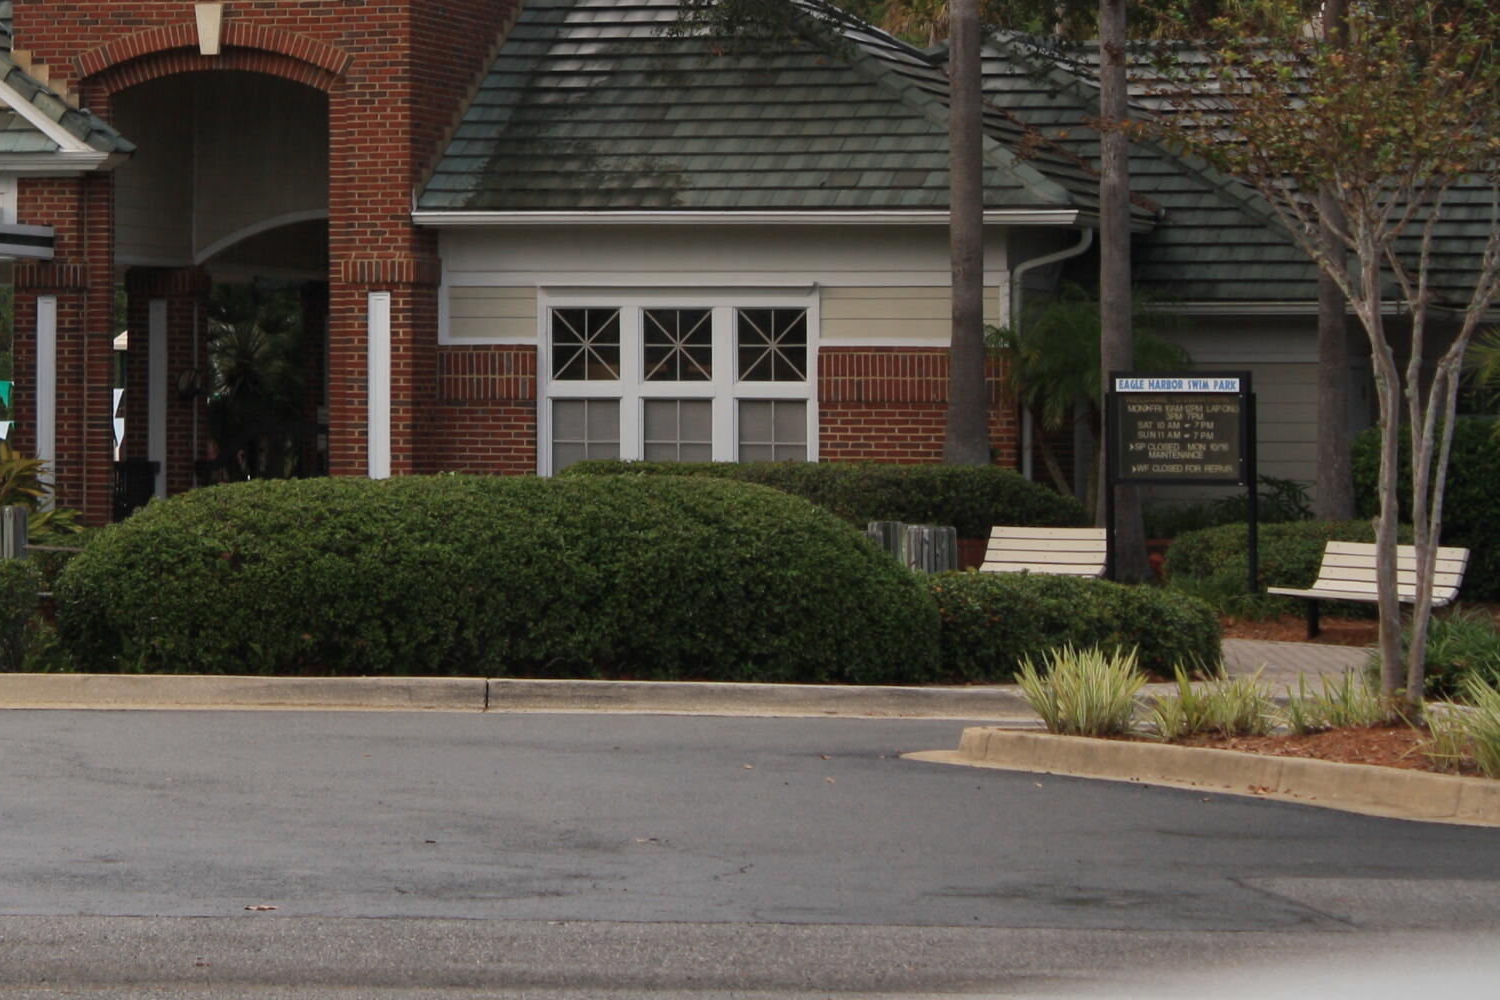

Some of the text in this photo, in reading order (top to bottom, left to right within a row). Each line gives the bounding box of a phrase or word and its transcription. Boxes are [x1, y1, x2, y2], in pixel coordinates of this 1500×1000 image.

[1118, 380, 1237, 390] EAGLE HARBOR SWIM PARK
[1138, 421, 1153, 429] SAT
[1138, 431, 1156, 440] SUN
[1148, 451, 1205, 459] MAINTENANCE
[1152, 464, 1184, 473] CLOSED
[1185, 464, 1202, 473] FOR
